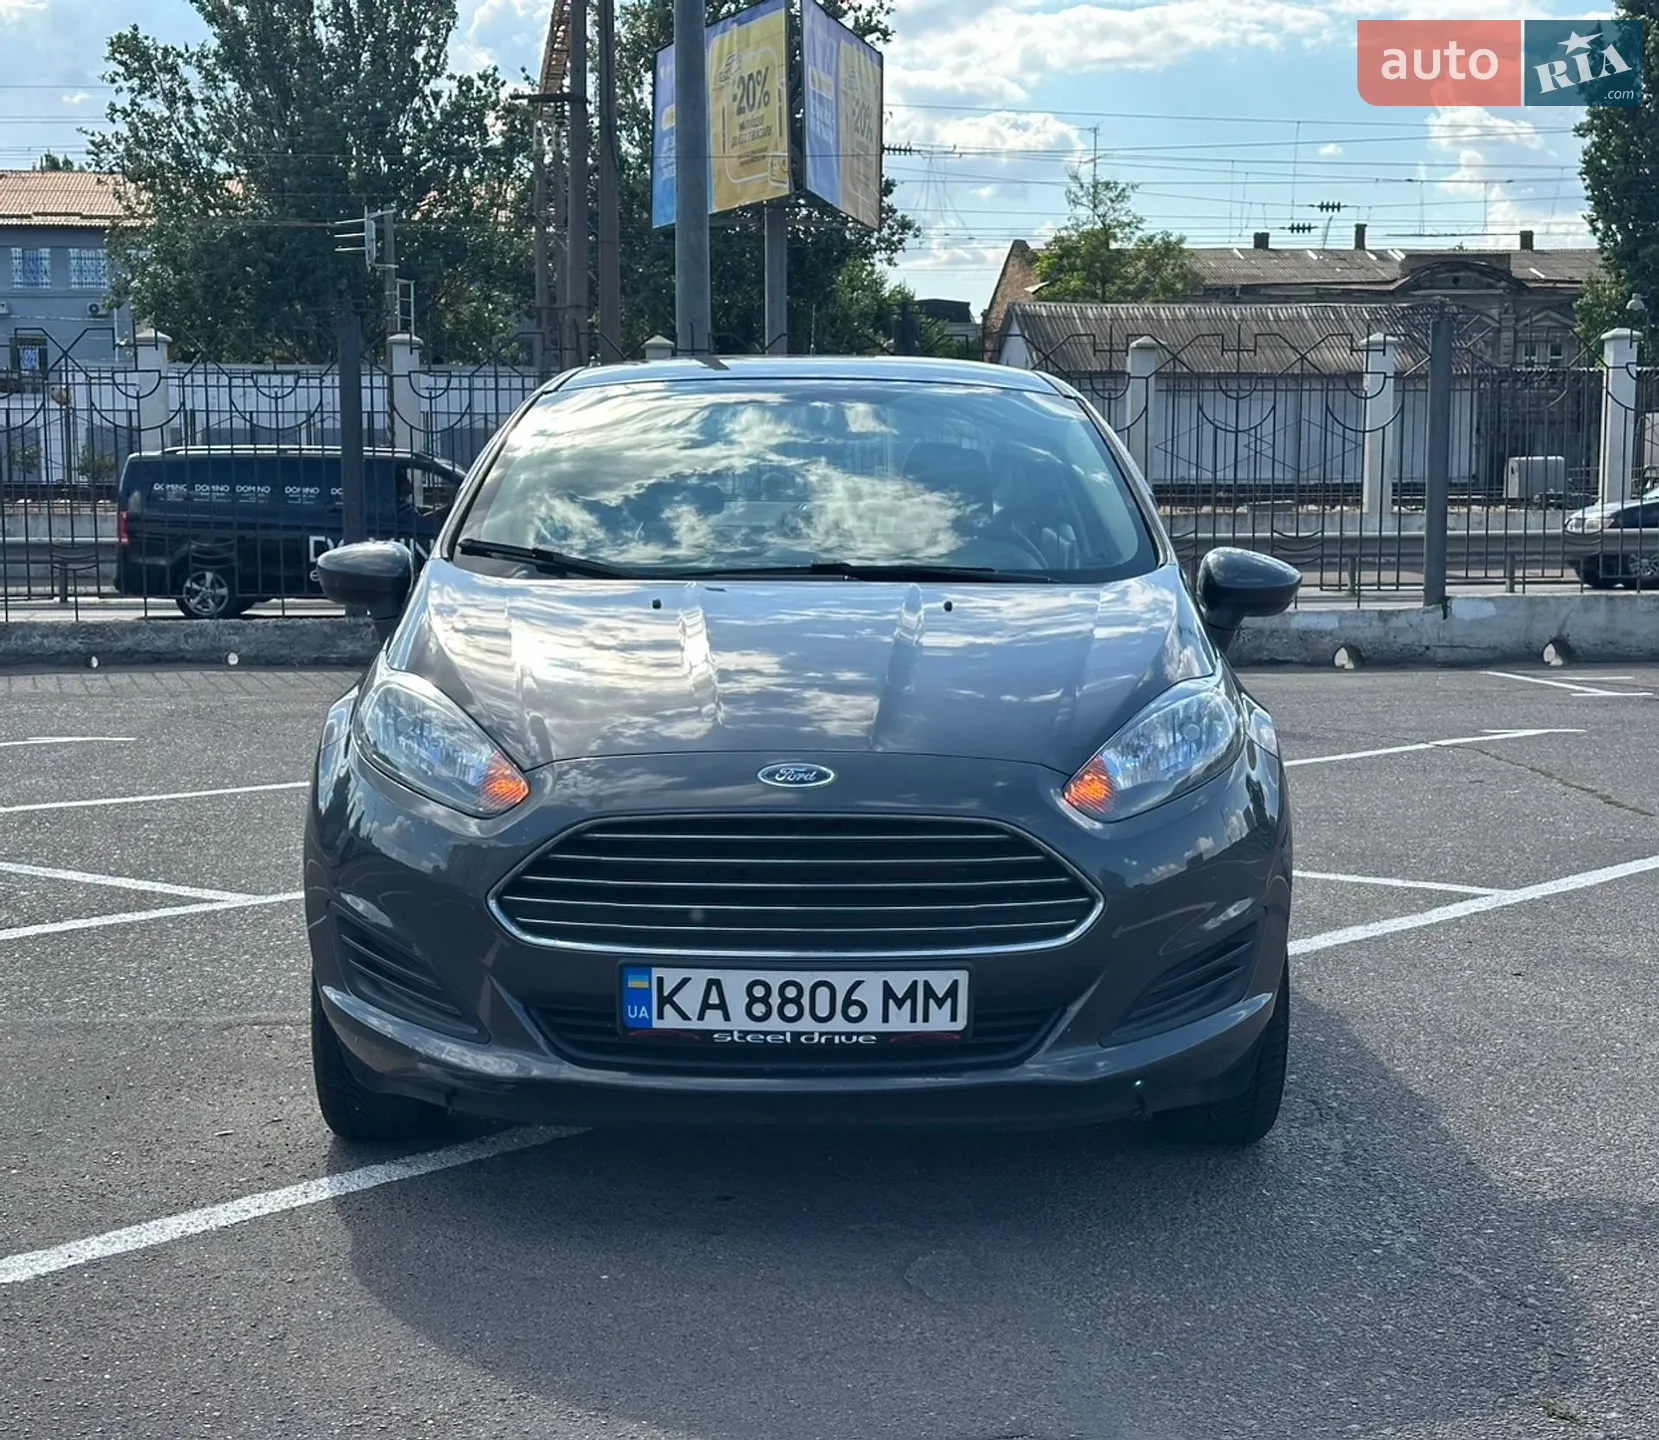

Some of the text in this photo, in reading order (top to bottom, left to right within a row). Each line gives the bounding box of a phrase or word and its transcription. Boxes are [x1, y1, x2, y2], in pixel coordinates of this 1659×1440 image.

[732, 66, 770, 116] -20%
[775, 767, 817, 781] Ford
[628, 976, 959, 1024] UA KA 8806 MM
[712, 1031, 878, 1044] steel drive
